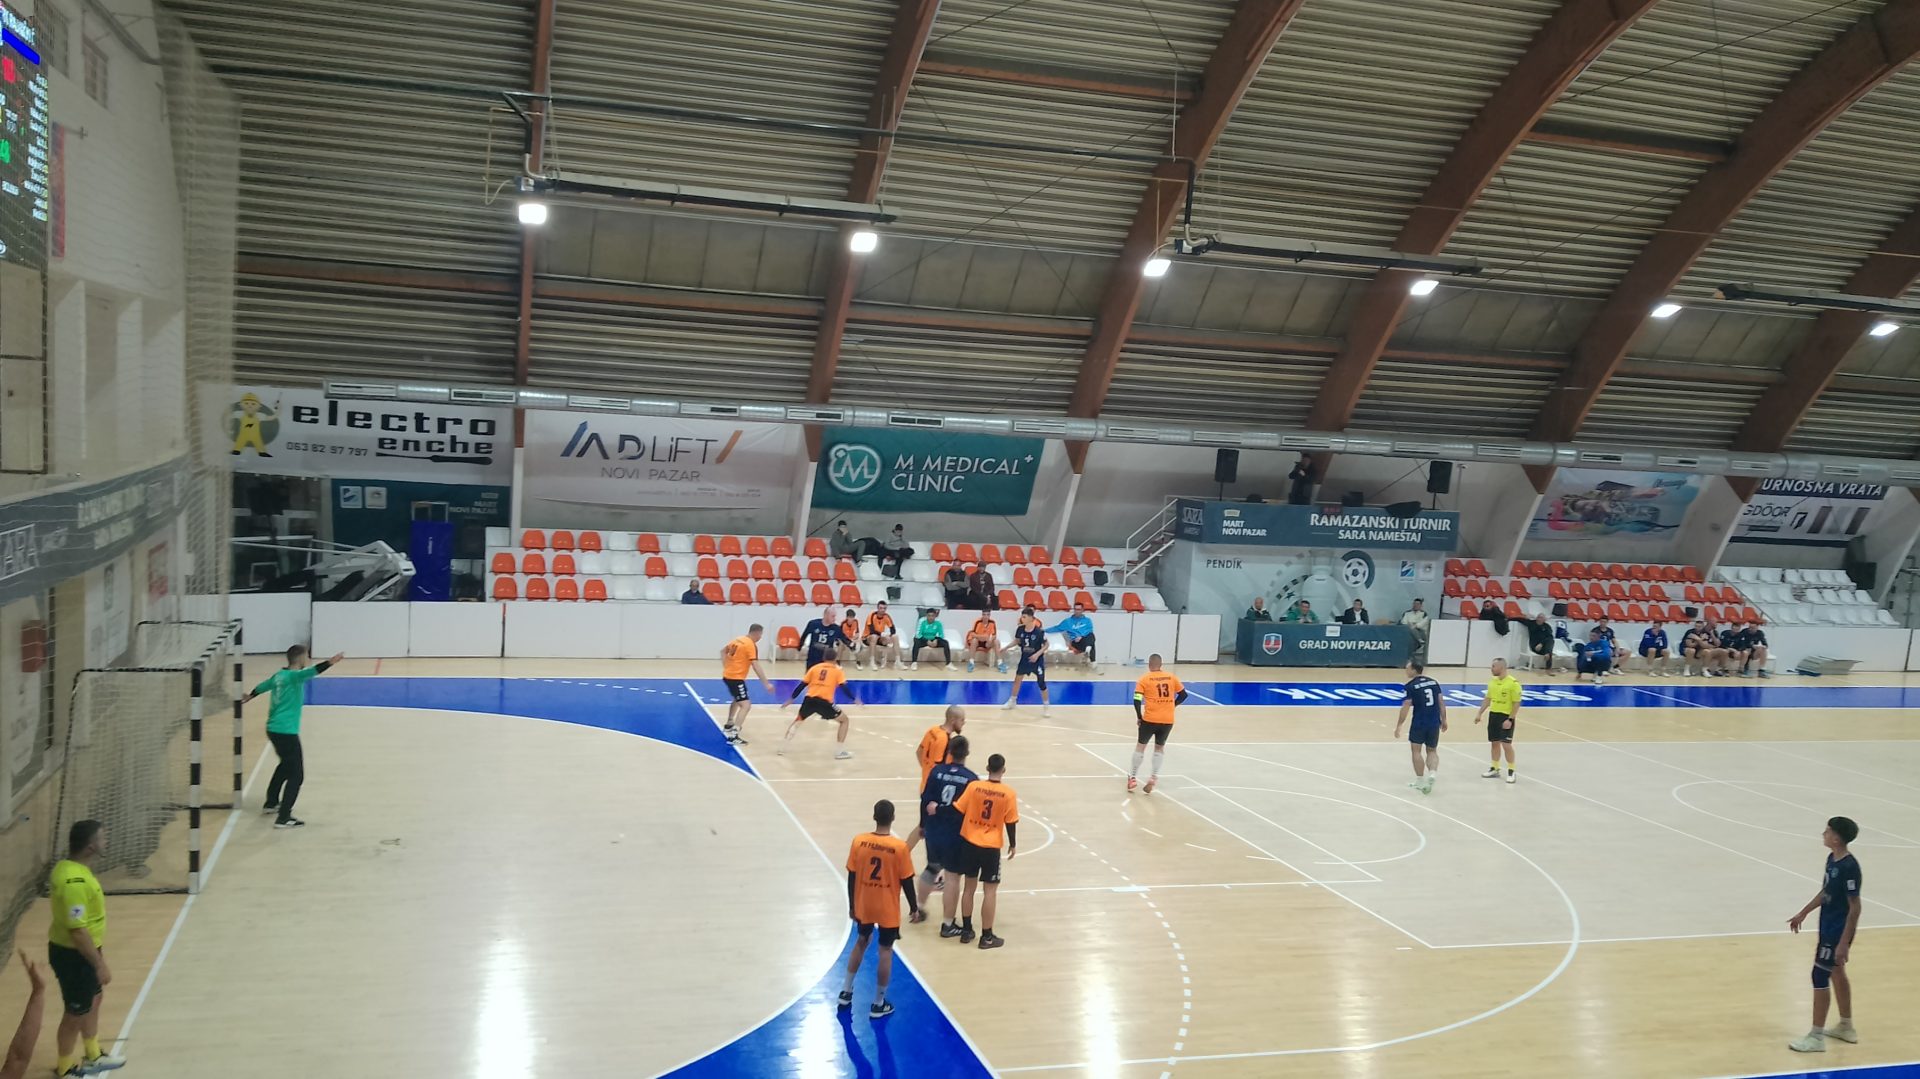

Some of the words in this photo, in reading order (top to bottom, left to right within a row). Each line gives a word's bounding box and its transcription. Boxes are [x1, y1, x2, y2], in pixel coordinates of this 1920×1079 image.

[292, 400, 496, 436] electro
[311, 443, 326, 453] 82
[330, 445, 344, 455] 97
[349, 447, 368, 457] 797
[377, 435, 493, 455] enche
[894, 454, 915, 471] M
[924, 455, 1021, 476] MEDICAL
[601, 467, 639, 480] NOVI
[648, 469, 701, 482] PAZAR
[891, 473, 965, 493] CLINIC
[1838, 483, 1882, 496] VRATA
[1222, 520, 1246, 528] MART
[1310, 513, 1400, 529] RAMAZANSKI
[1403, 518, 1451, 531] TURNIR
[1222, 528, 1241, 536] NOVI
[1242, 528, 1267, 537] PAZAR
[1338, 530, 1367, 540] SARA
[1368, 529, 1422, 543] NAMEŠTAJ
[1299, 639, 1329, 650] GRAD
[1330, 640, 1356, 650] NOVI
[1358, 640, 1391, 650] PAZAR
[1156, 683, 1170, 698] 13
[1424, 688, 1434, 707] 3
[981, 799, 994, 820] 3
[870, 856, 882, 881] 2
